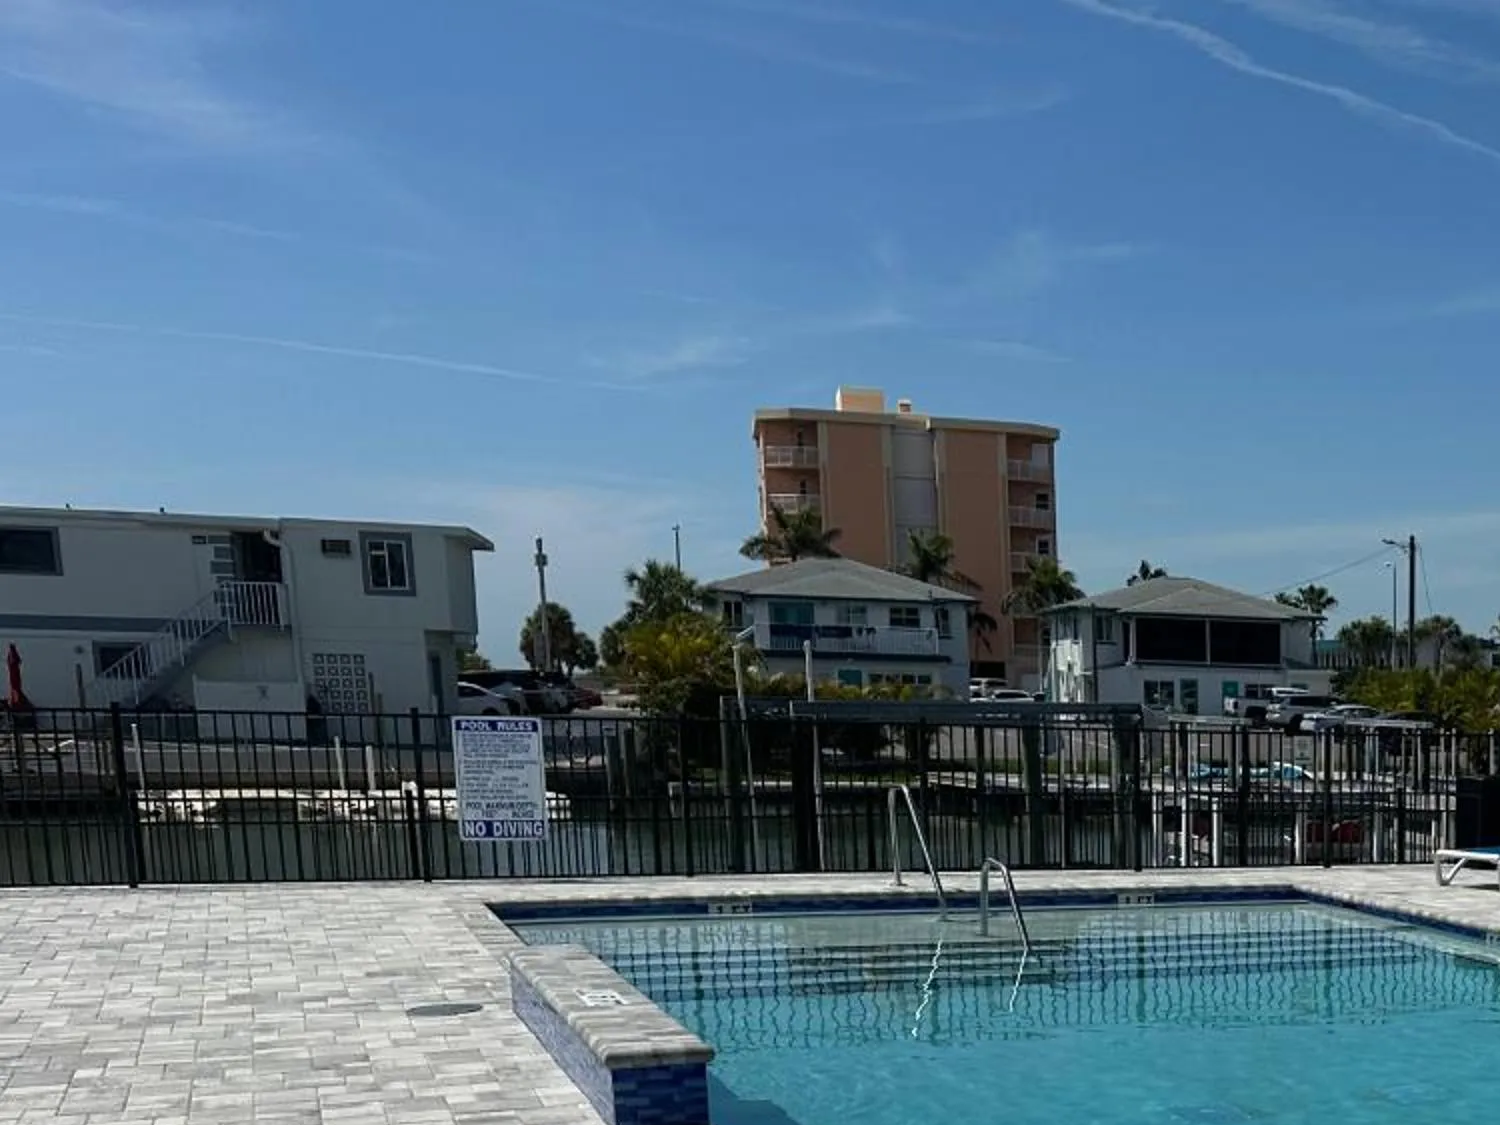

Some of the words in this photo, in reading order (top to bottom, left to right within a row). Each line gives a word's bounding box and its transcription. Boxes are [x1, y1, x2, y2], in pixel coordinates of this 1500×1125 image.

[460, 721, 491, 731] POOL
[497, 721, 533, 731] RULES
[465, 821, 487, 837] NO
[493, 821, 543, 838] DIVING
